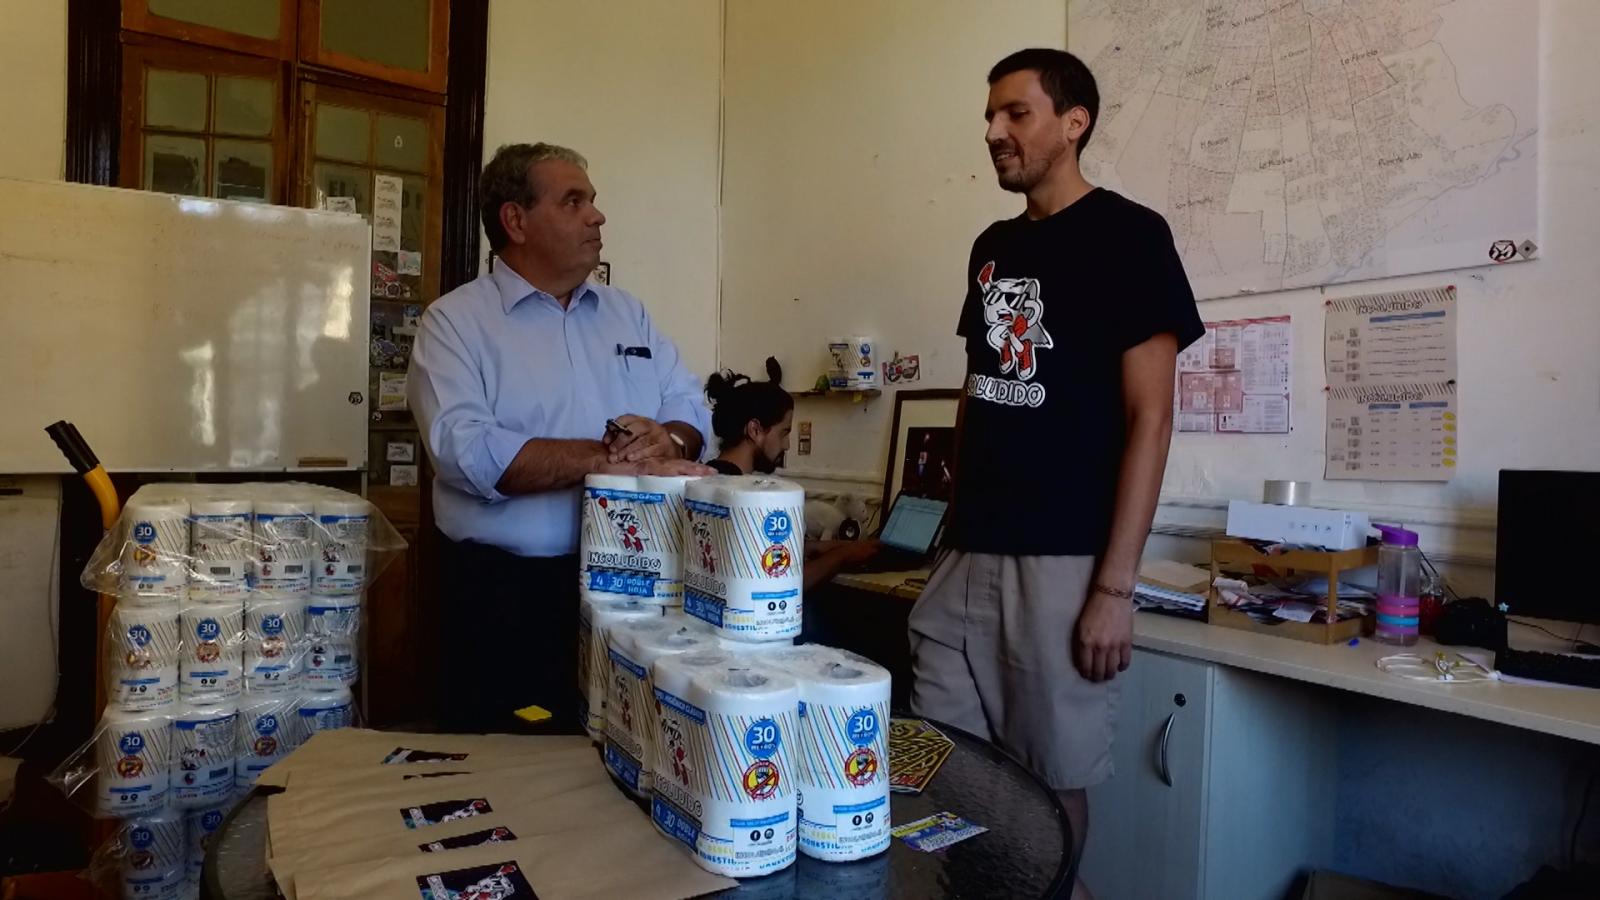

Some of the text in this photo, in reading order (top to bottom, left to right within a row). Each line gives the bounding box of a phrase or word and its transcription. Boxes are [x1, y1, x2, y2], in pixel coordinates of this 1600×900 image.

[768, 516, 788, 532] 30
[137, 526, 153, 536] 30
[611, 576, 624, 588] 30
[200, 623, 216, 632] 30
[266, 618, 280, 628] 30
[131, 629, 147, 640] 30
[261, 718, 275, 728] 30
[853, 714, 875, 733] 30
[751, 725, 776, 745] 30
[125, 736, 141, 746] 30
[205, 814, 221, 824] 30
[664, 811, 676, 828] 30
[133, 831, 150, 841] 30
